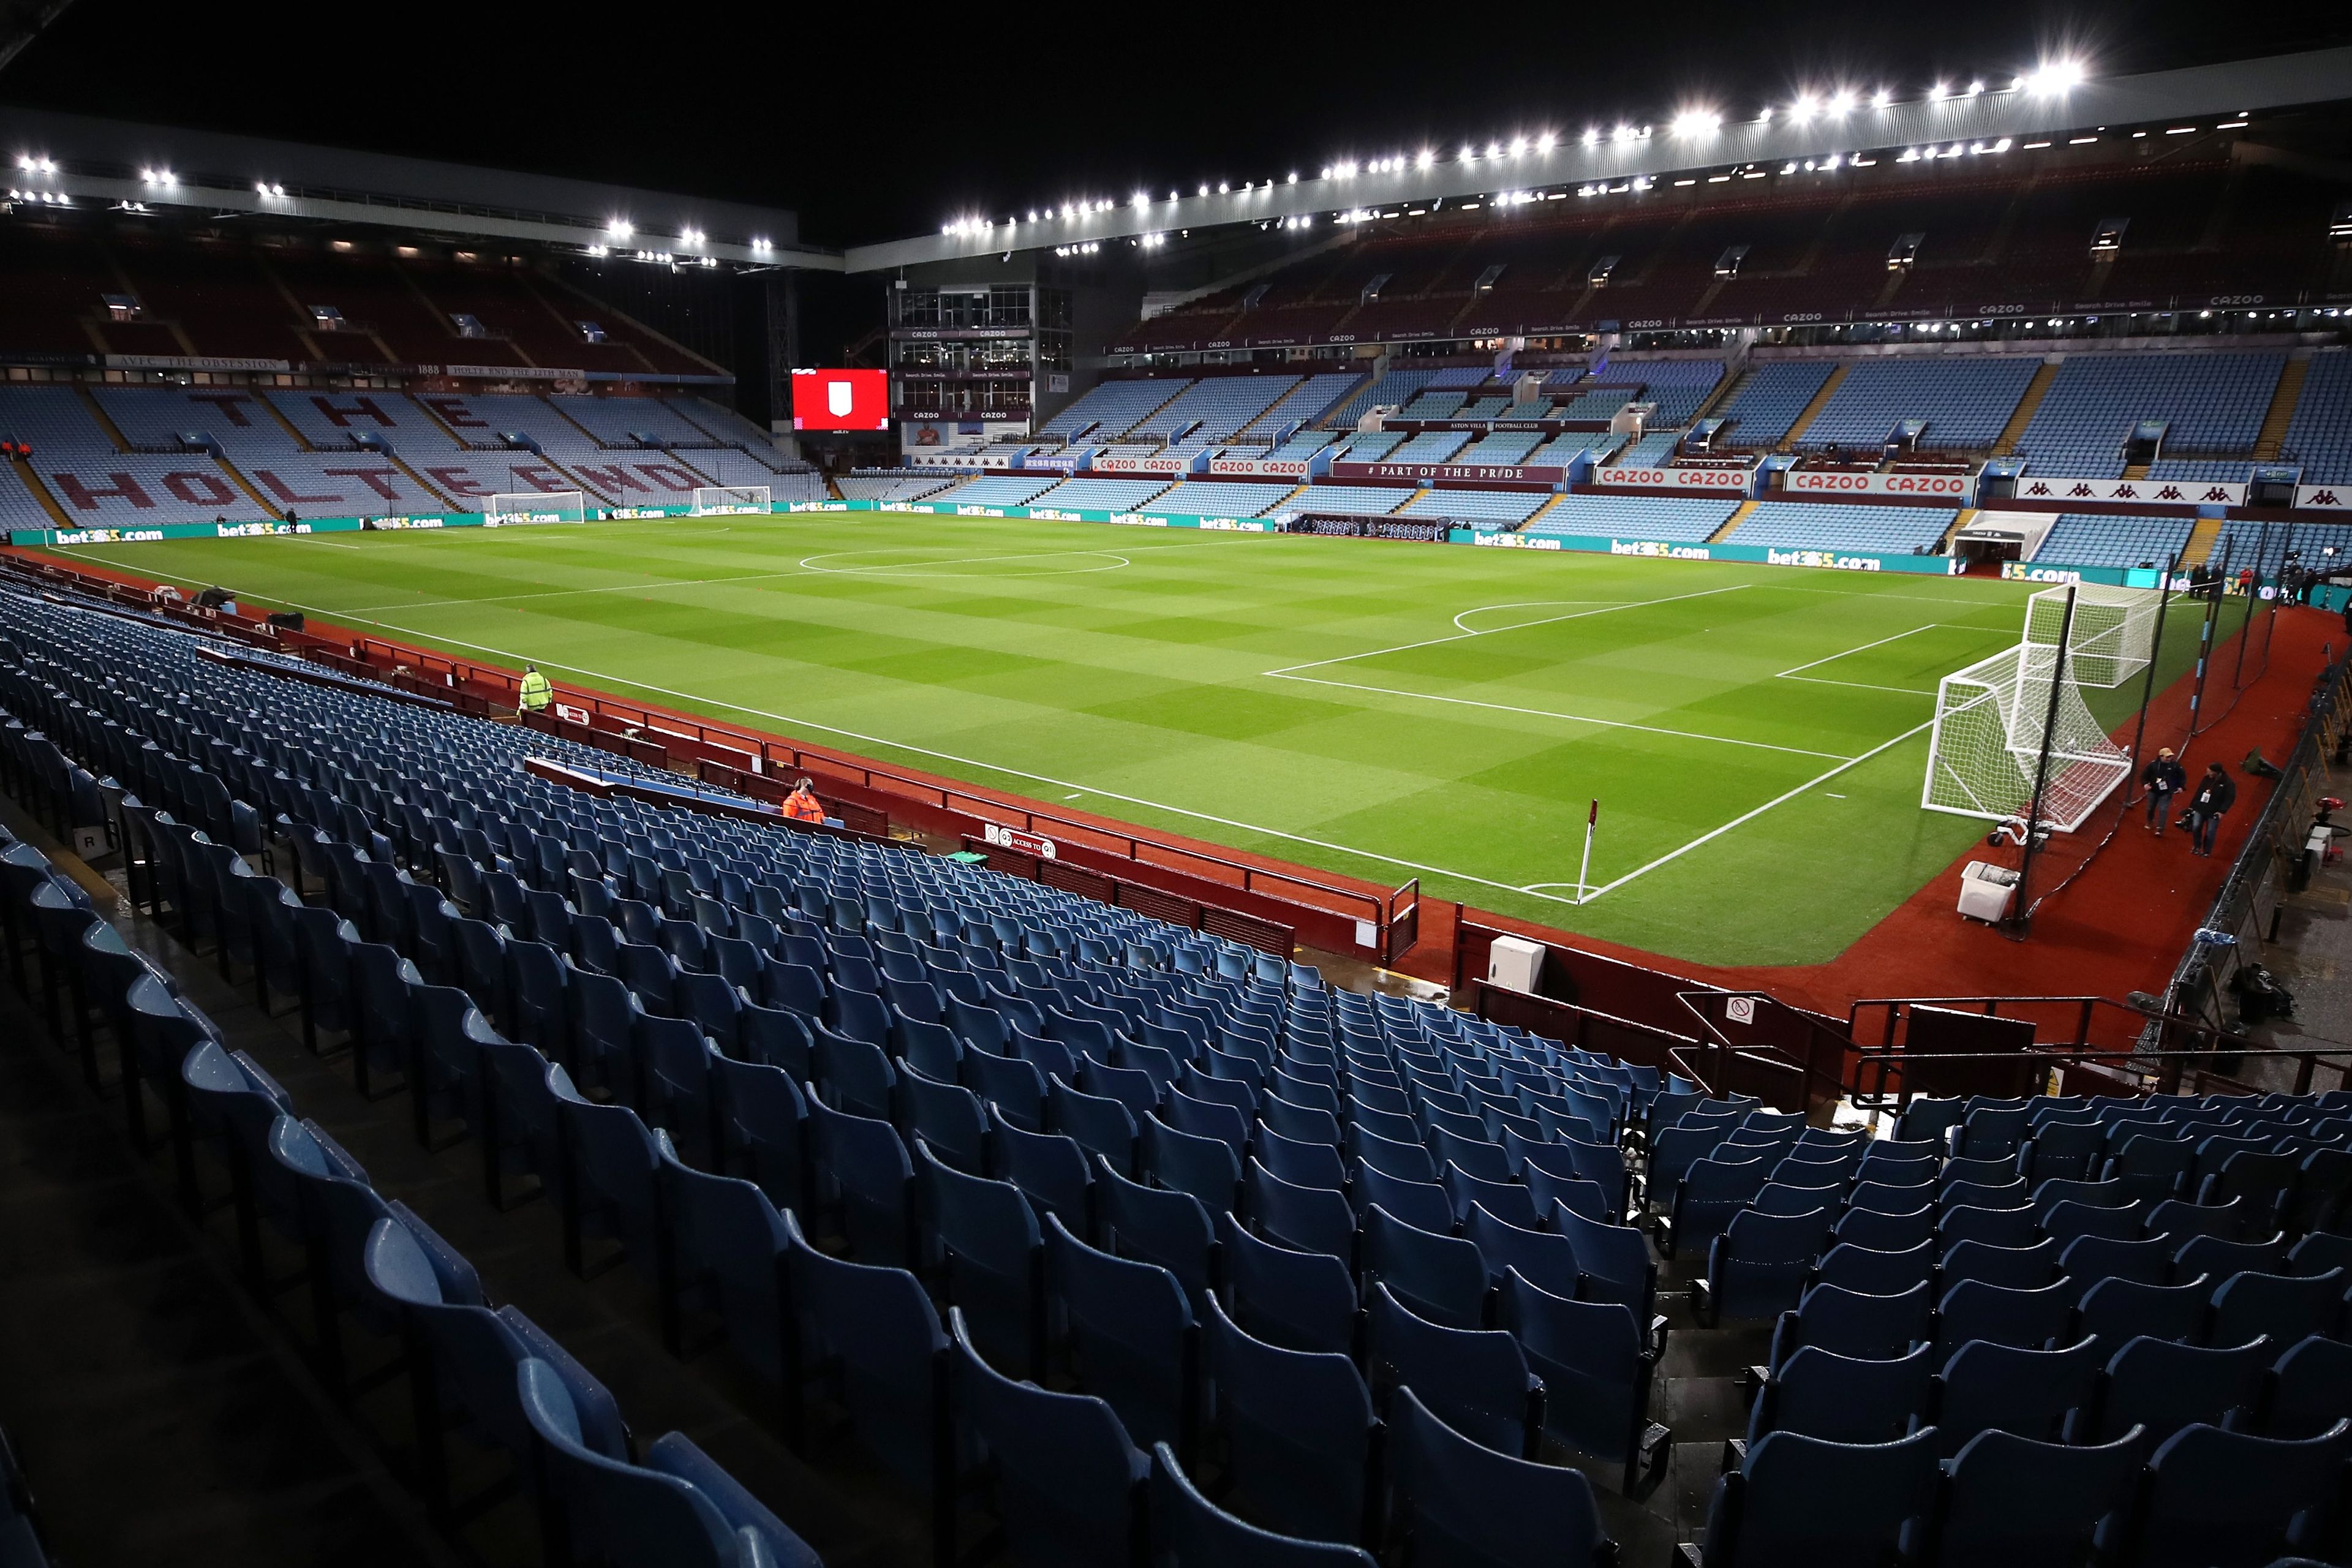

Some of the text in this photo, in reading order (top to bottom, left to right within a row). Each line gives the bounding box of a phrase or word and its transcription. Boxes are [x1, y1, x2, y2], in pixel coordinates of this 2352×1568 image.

[2210, 295, 2263, 305] CAZOO
[1979, 304, 2024, 314] CAZOO
[1784, 313, 1822, 322] CAZOO
[122, 356, 276, 368] AVFC THE OBSESSION
[418, 365, 440, 374] 1888
[189, 394, 489, 427] THE
[1101, 460, 1182, 470] CAZOO CAZOO
[1212, 462, 1306, 473] CAZOO CAZOO
[1381, 466, 1413, 476] PART
[1420, 467, 1437, 476] OF
[1444, 468, 1471, 477] THE
[1603, 470, 1744, 486] CAZOO CAZOO
[53, 464, 705, 510] HOLTE END
[1796, 475, 1964, 493] CAZOO CAZOO
[597, 509, 665, 520] bt365.com
[85, 837, 94, 848] R
[1013, 839, 1032, 848] ACCESS
